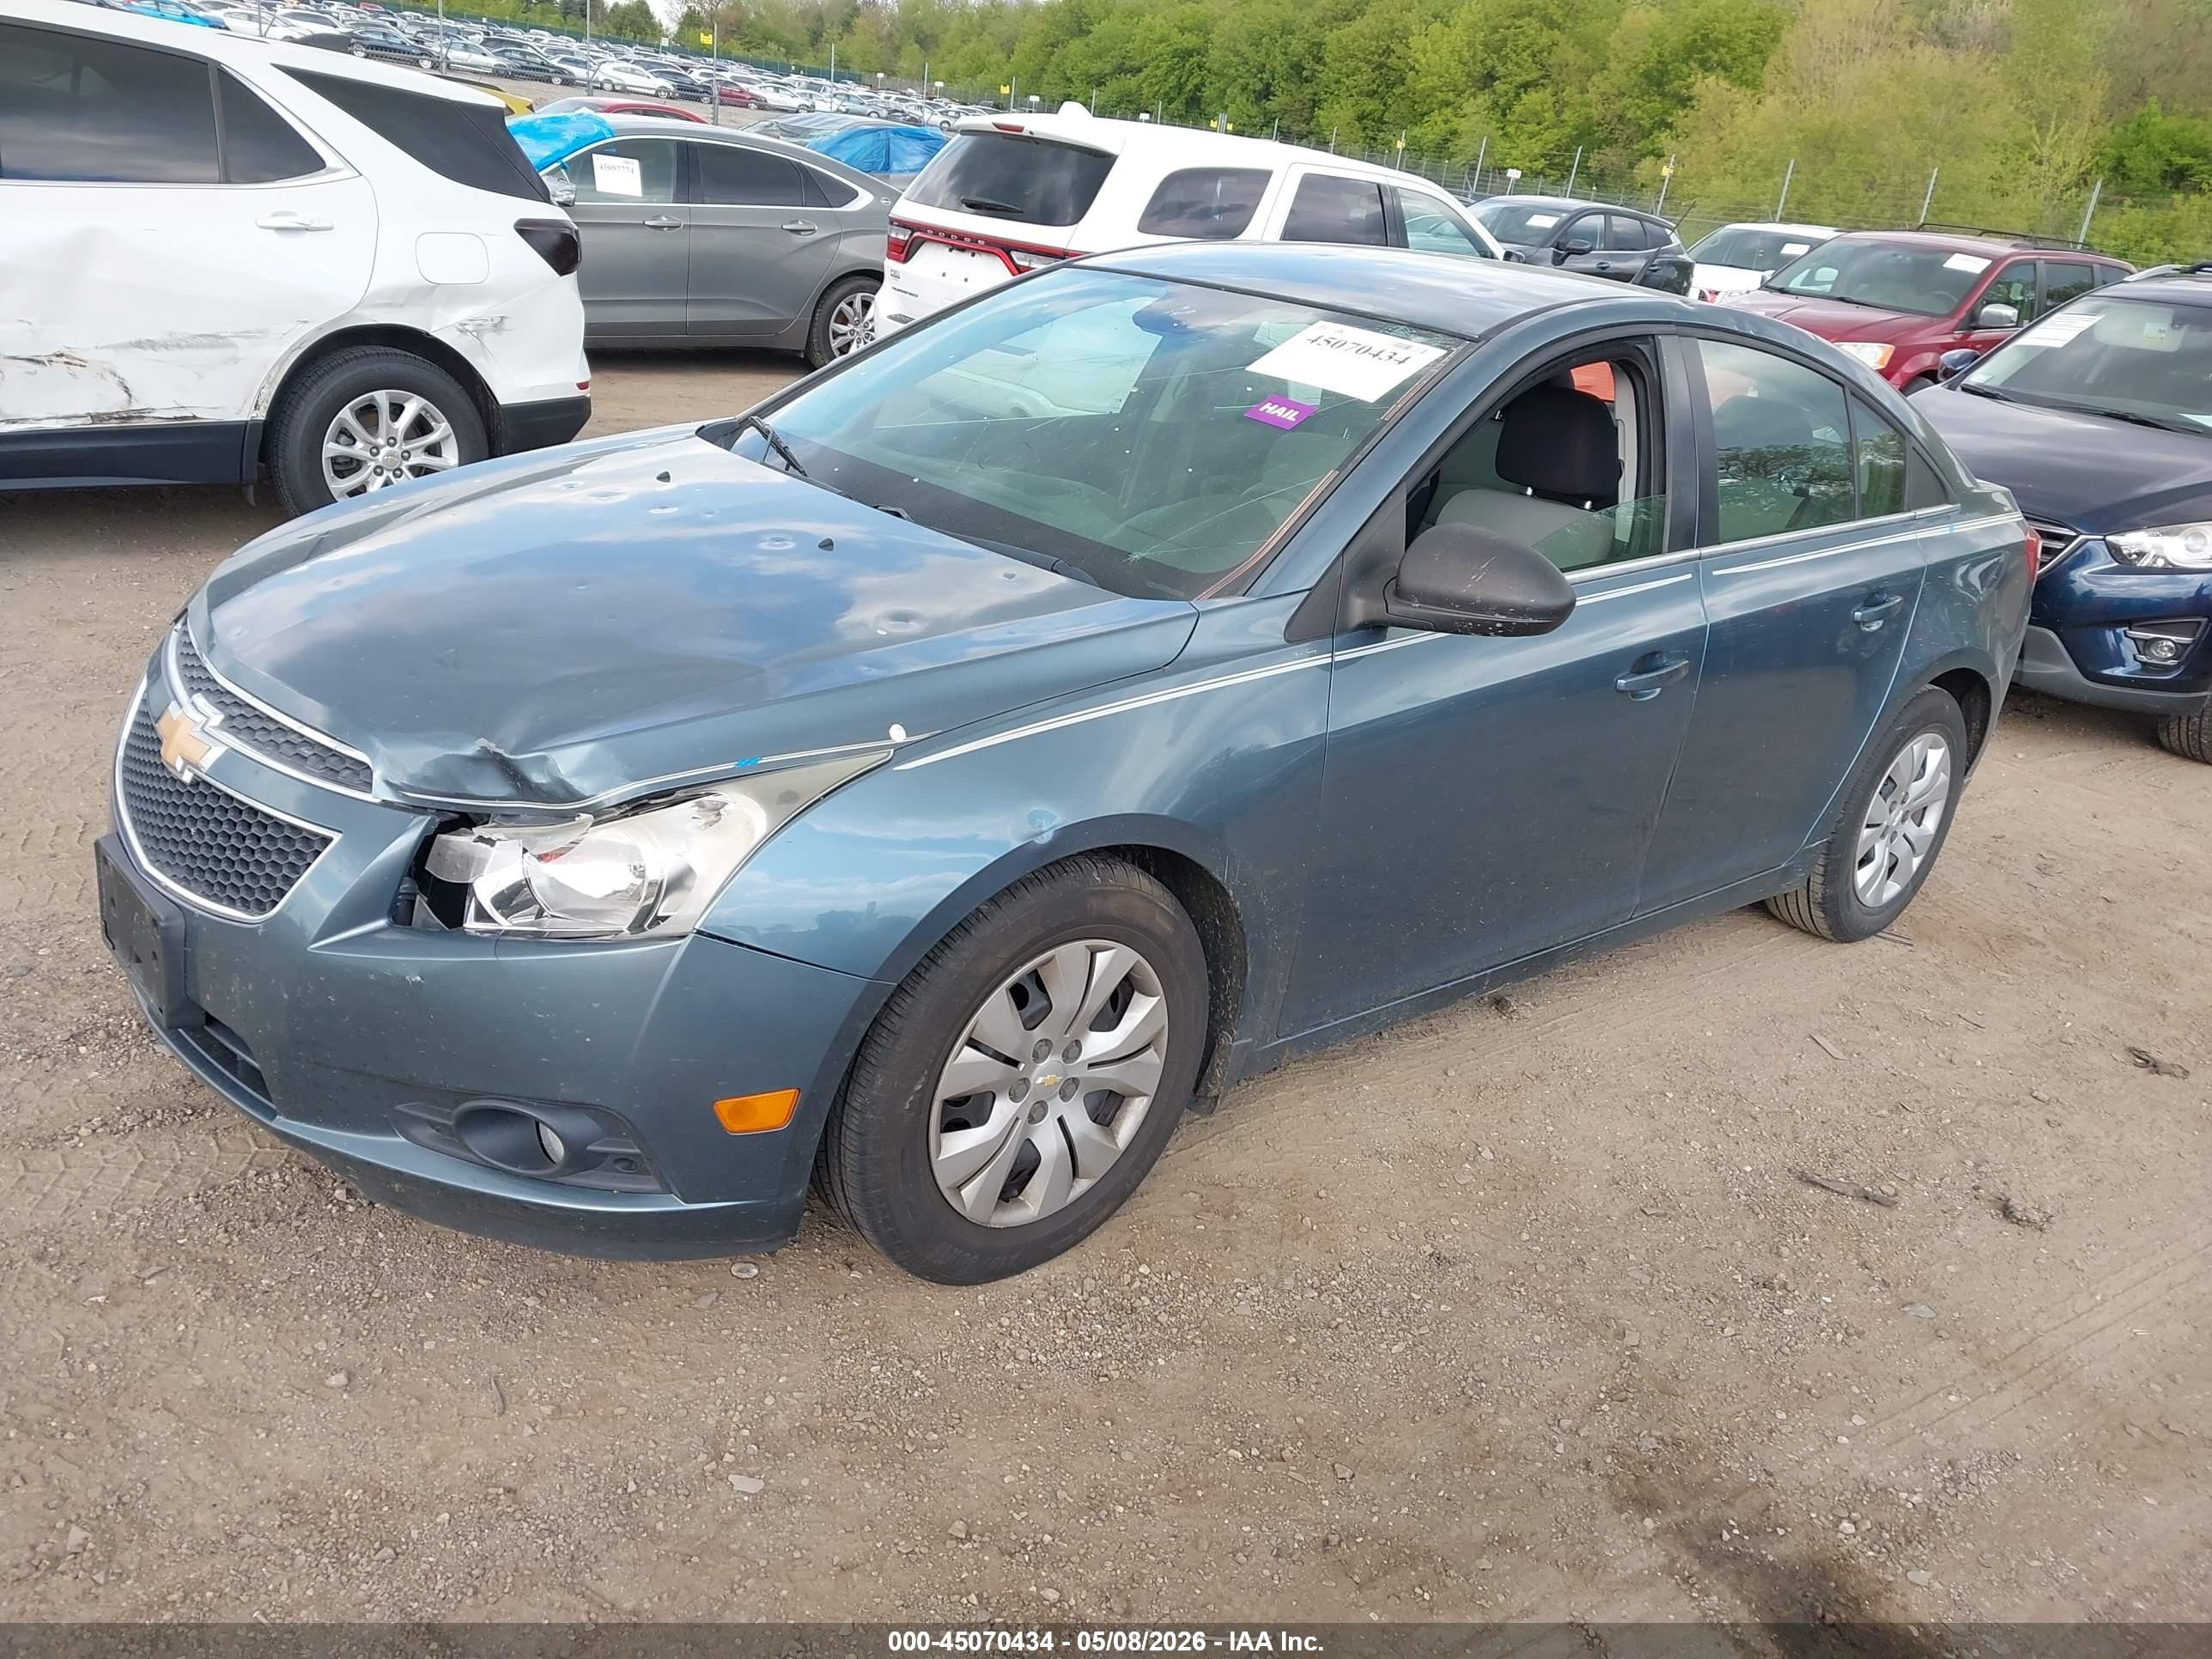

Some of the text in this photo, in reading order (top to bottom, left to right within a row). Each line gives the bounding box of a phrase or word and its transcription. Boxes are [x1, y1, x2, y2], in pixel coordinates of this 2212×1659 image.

[927, 229, 986, 246] DODGE
[1306, 335, 1412, 365] 45070434
[1259, 402, 1300, 422] HAIL
